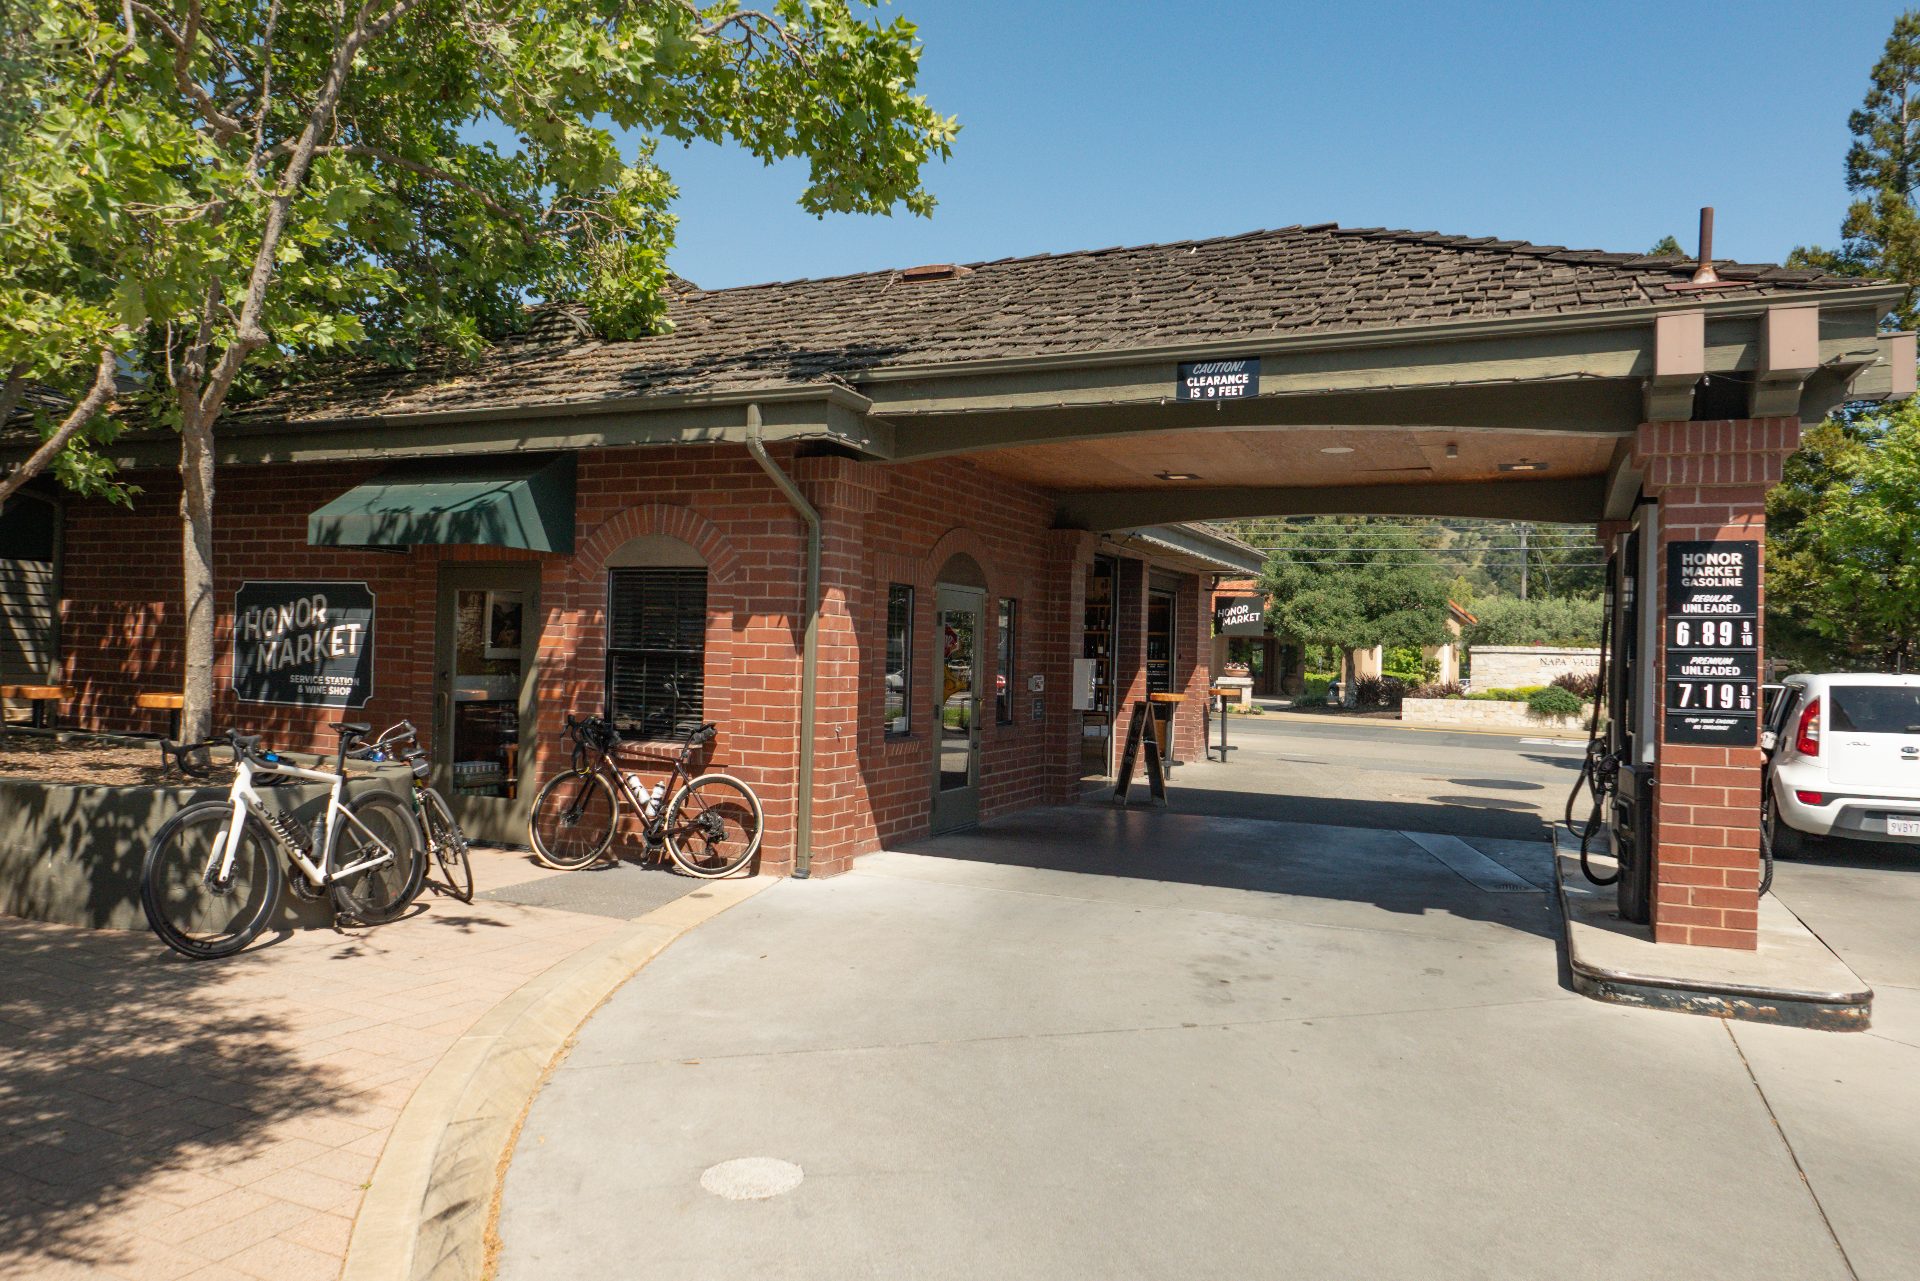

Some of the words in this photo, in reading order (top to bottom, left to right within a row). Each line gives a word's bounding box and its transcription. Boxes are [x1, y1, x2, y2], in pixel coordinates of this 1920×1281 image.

[1192, 360, 1246, 375] CAUTION!
[1186, 373, 1249, 387] CLEARANCE
[1190, 388, 1201, 399] IS
[1207, 386, 1216, 398] 9
[1218, 385, 1245, 397] FEET
[1681, 552, 1743, 566] HONOR
[1681, 566, 1743, 577] MARKET
[1681, 577, 1743, 587] GASOLINE
[1691, 594, 1734, 603] REGULAR
[1217, 604, 1249, 618] HONOR
[1682, 603, 1742, 614] UNLEADED
[243, 593, 329, 641] HONOR
[1222, 612, 1261, 626] MARKET
[1676, 621, 1733, 646] 6.89
[256, 623, 361, 673] MARKET
[1540, 657, 1567, 666] NAPA
[1573, 658, 1600, 667] VALLE
[1690, 656, 1735, 665] PREMIUM
[1681, 665, 1741, 676] UNLEADED
[290, 674, 323, 684] SERVICE
[324, 676, 360, 686] STATION
[297, 685, 304, 693] &
[305, 685, 327, 694] WINE
[328, 686, 352, 696] SHOP
[1679, 683, 1734, 709] 7.19
